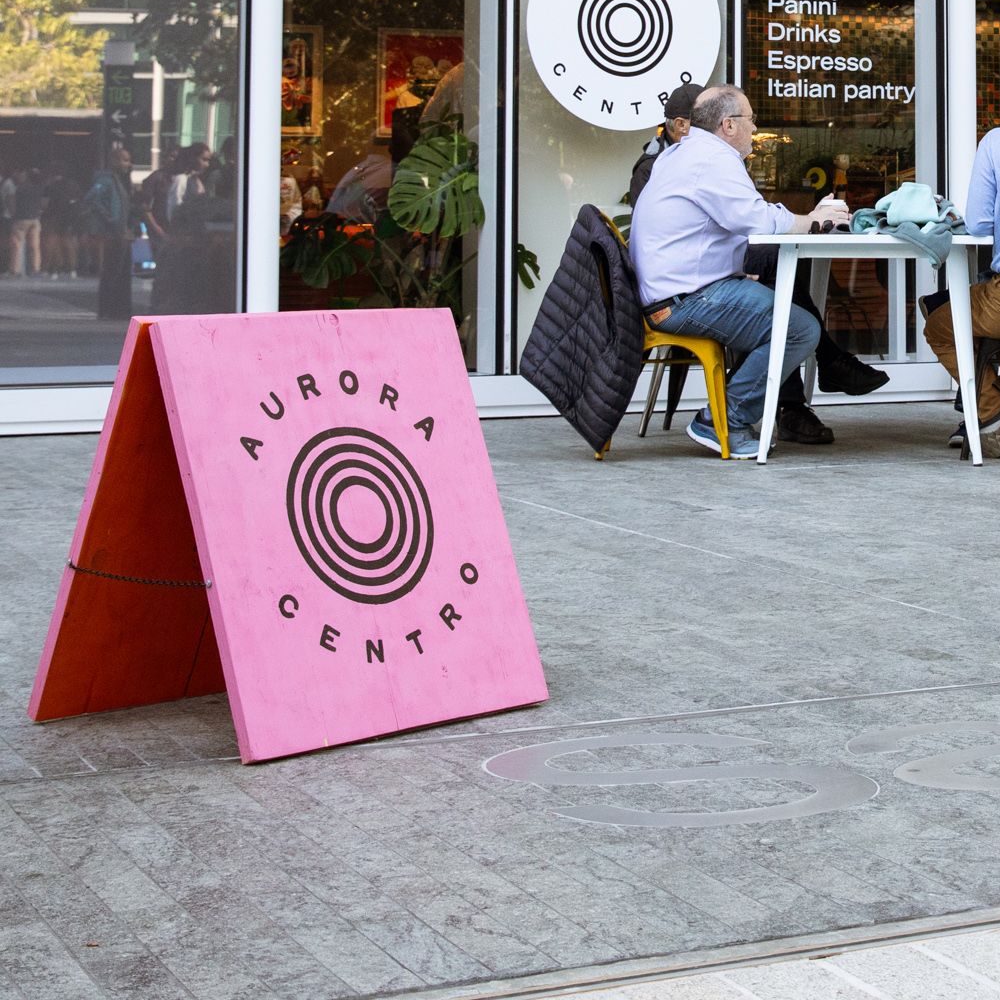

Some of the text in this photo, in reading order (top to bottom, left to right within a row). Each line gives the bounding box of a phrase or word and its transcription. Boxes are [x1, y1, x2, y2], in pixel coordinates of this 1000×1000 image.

[767, 22, 841, 44] Drinks
[767, 50, 873, 74] Espresso
[553, 63, 692, 115] CENTRO
[767, 78, 916, 104] Italian pantry
[240, 370, 435, 461] AURORA
[278, 562, 480, 664] CENTRO
